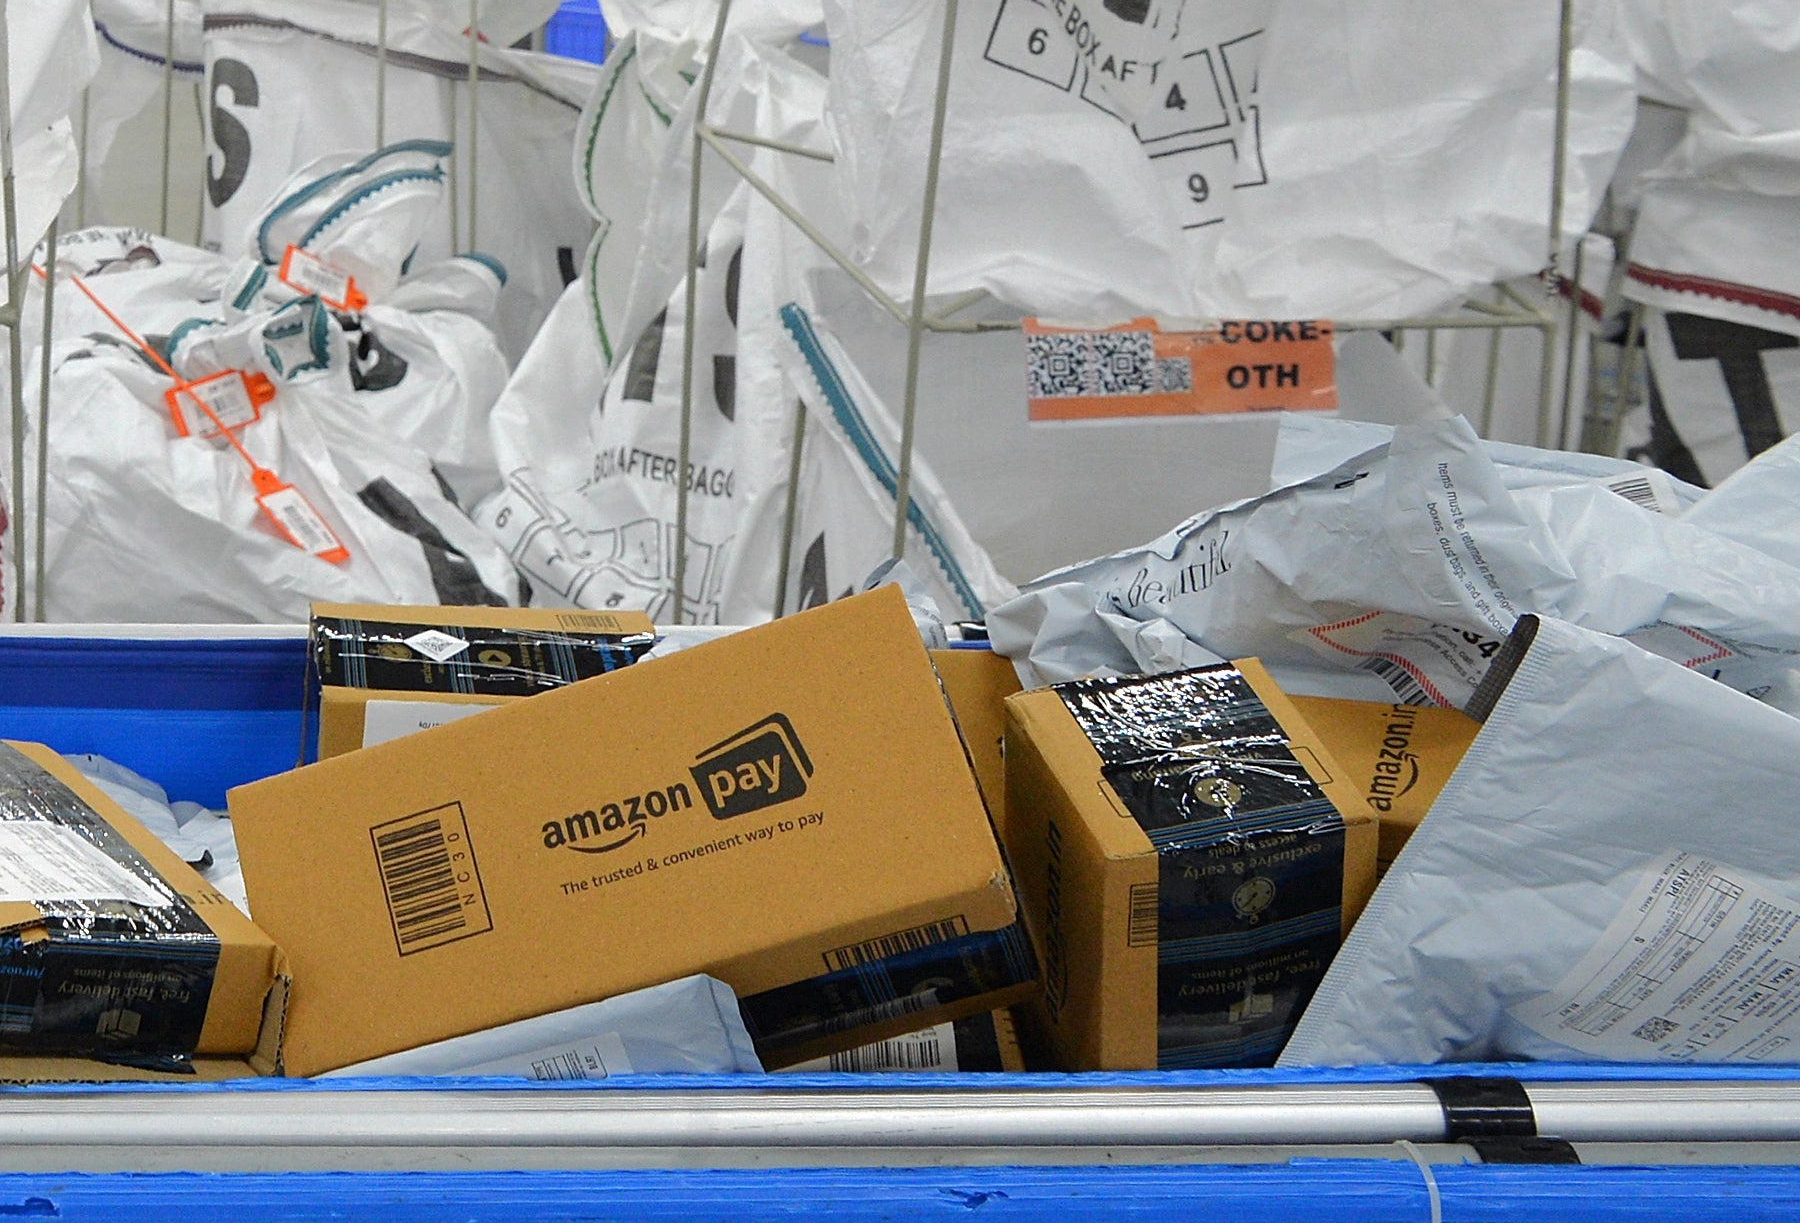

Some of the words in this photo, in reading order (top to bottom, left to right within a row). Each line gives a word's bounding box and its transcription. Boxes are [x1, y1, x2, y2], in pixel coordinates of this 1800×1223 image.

[1028, 28, 1049, 55] 6
[1164, 82, 1187, 111] 4
[1187, 173, 1210, 204] 9
[1220, 320, 1331, 344] COKE-
[1227, 363, 1300, 389] OTH
[616, 446, 676, 485] AFTER
[1438, 462, 1450, 491] Items
[1447, 491, 1463, 519] must
[495, 507, 512, 528] 6
[605, 592, 625, 608] 8
[1465, 580, 1480, 600] and
[1475, 598, 1490, 616] gift
[1488, 614, 1509, 637] boxe
[541, 781, 694, 850] amazon
[706, 750, 785, 808] pay
[561, 878, 589, 896] The
[592, 861, 645, 887] trusted
[647, 857, 660, 872] &
[663, 834, 744, 867] convenient
[745, 824, 775, 845] way
[777, 820, 795, 833] to
[798, 810, 826, 831] pay
[1250, 843, 1322, 867] exclusive
[1232, 861, 1245, 874] &
[1634, 935, 1646, 944] S
[1769, 966, 1794, 985] MAA
[57, 980, 120, 999] delivery
[1178, 979, 1246, 997] delivery
[1735, 991, 1763, 1011] MAAL
